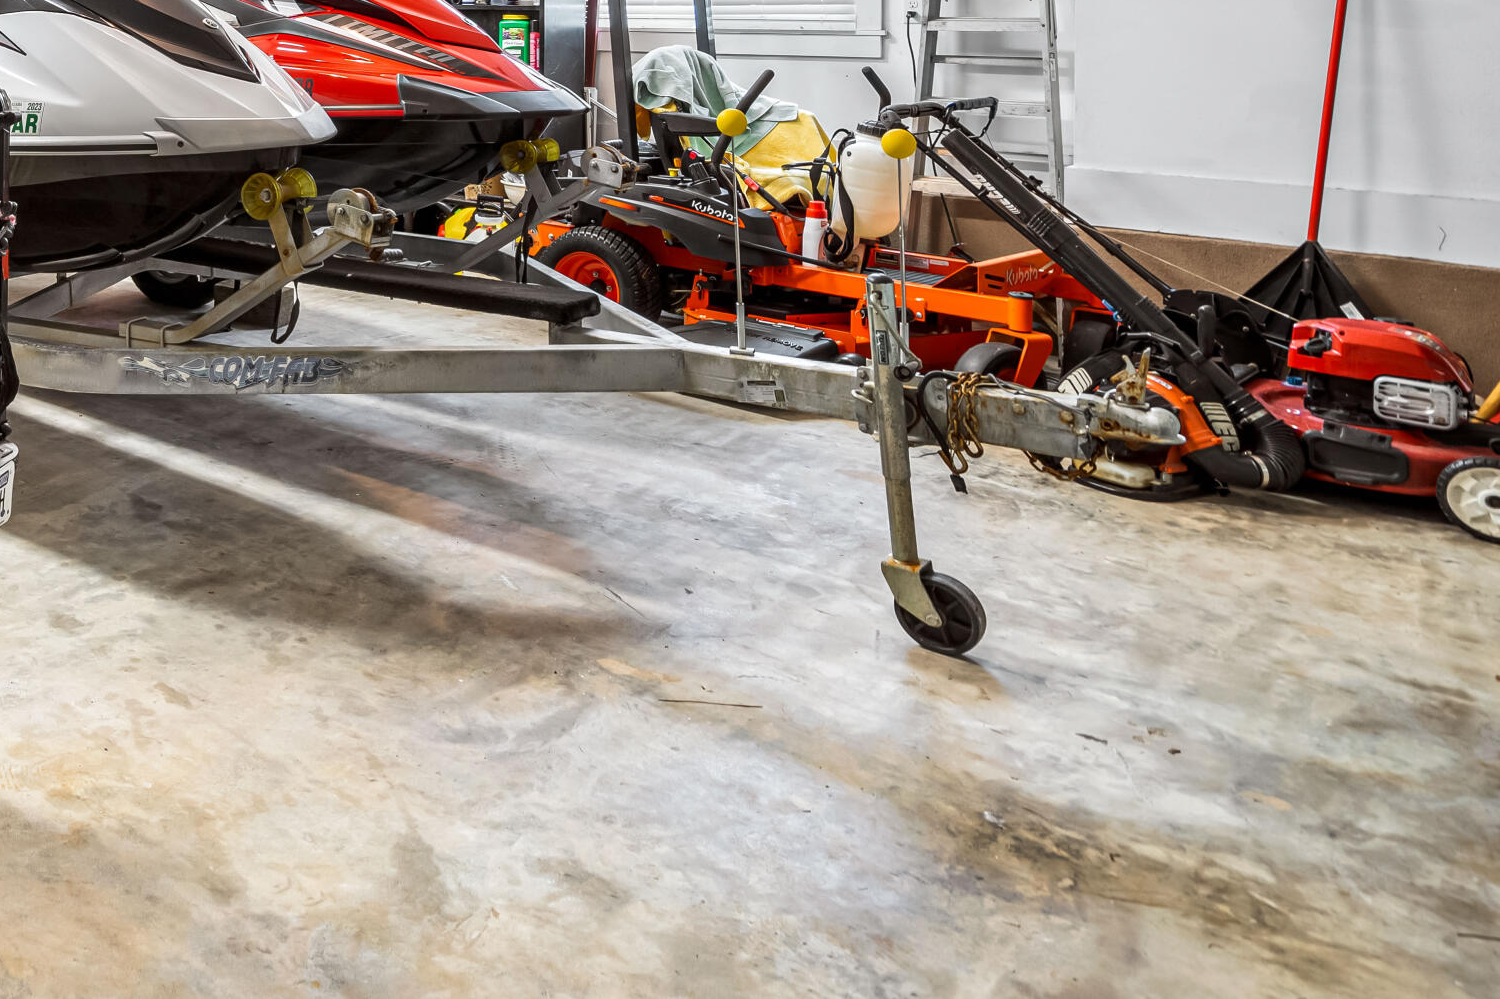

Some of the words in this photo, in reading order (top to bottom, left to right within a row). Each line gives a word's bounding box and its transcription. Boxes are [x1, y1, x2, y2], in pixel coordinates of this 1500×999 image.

[322, 13, 457, 63] LIMITED
[27, 102, 43, 111] 2023
[11, 113, 39, 134] AR
[691, 199, 734, 222] Kubota
[1006, 264, 1038, 286] Kubota
[762, 335, 804, 352] REMOVE
